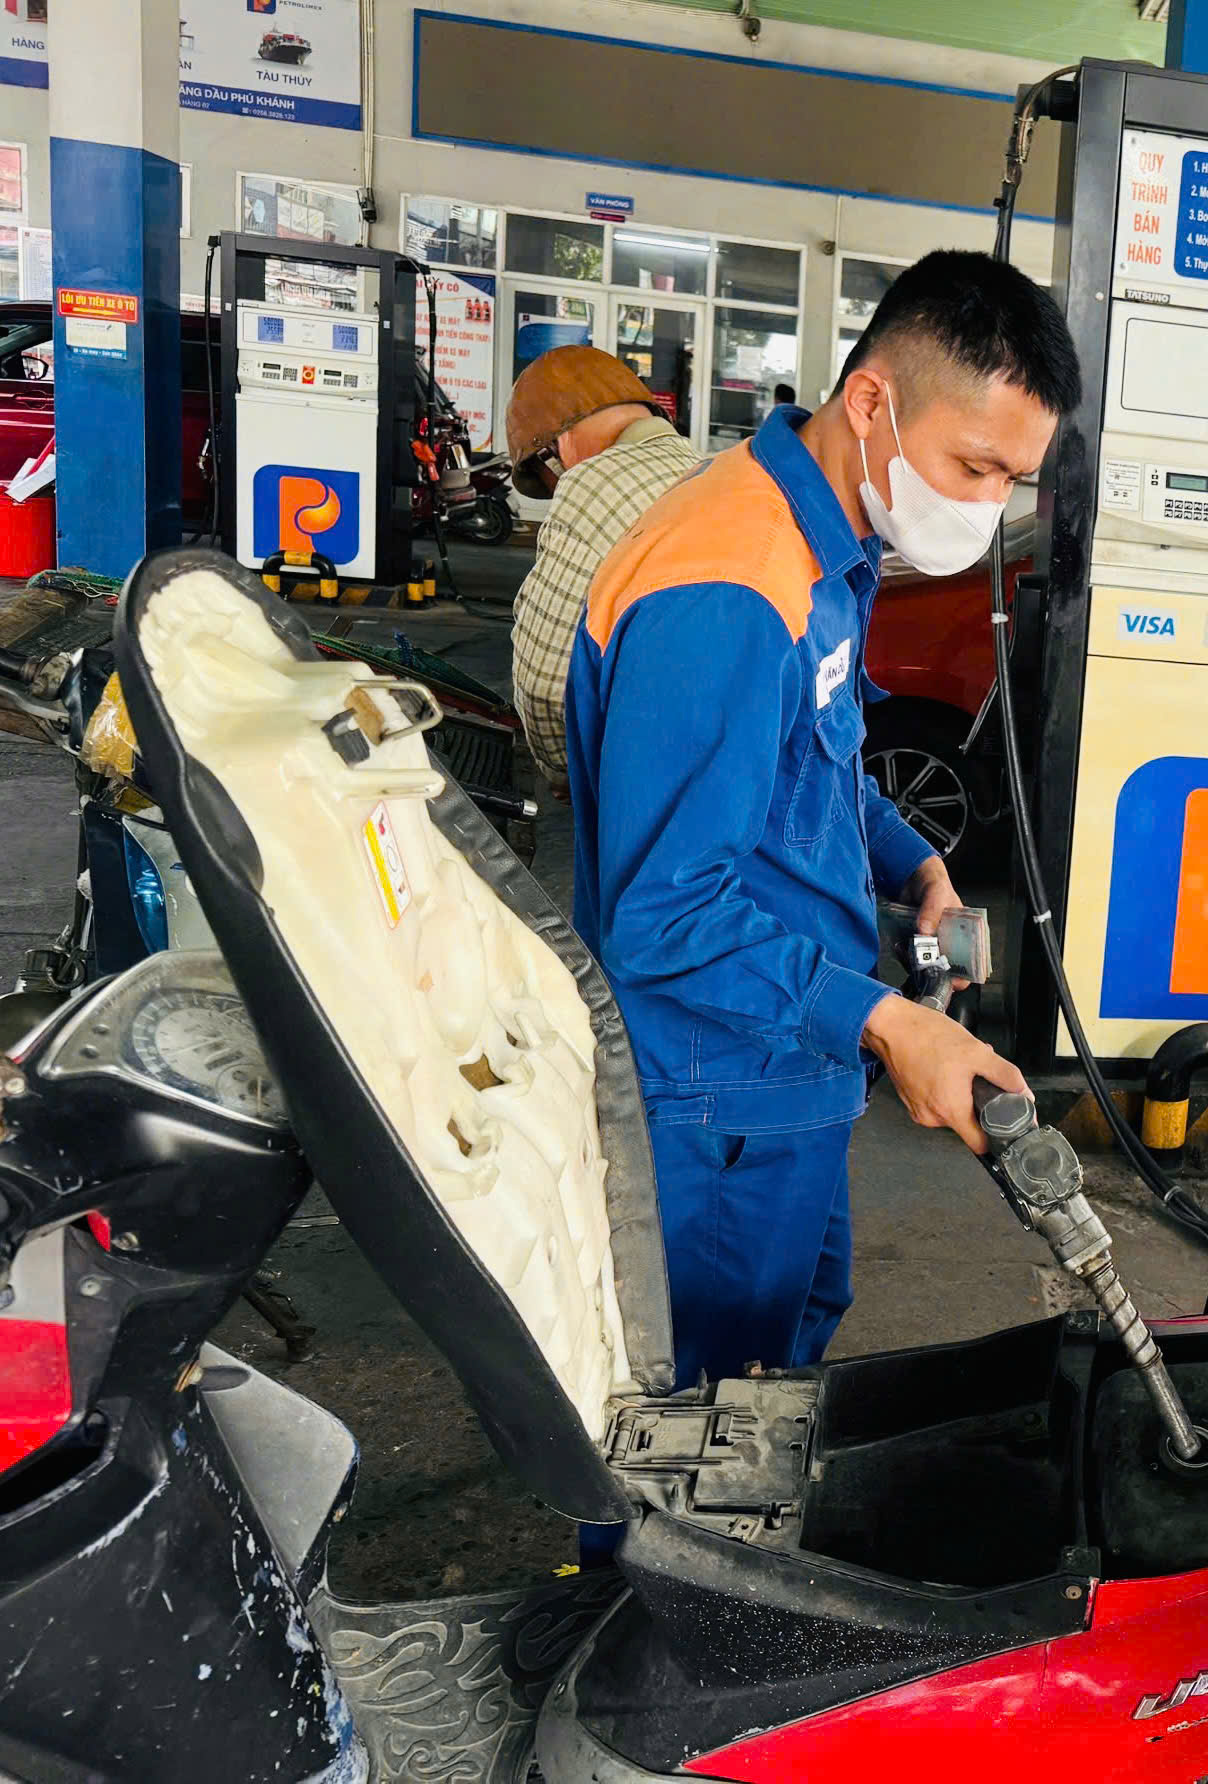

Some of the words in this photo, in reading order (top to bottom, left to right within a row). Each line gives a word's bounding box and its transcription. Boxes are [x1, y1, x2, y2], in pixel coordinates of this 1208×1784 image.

[256, 69, 279, 82] TÀU
[179, 85, 202, 97] ĂNG
[205, 87, 228, 100] DẦU
[230, 91, 254, 103] PHÚ
[256, 95, 295, 110] KHÁNH
[1139, 151, 1164, 173] QUY
[1131, 180, 1168, 204] TRÌNH
[1134, 210, 1160, 234] BÁN
[1186, 233, 1194, 245] 4.
[1195, 234, 1208, 248] Mời
[1127, 240, 1162, 265] HÀNG
[1185, 257, 1192, 268] 5.
[1127, 290, 1168, 303] TATSUNO
[1121, 613, 1175, 637] VISA
